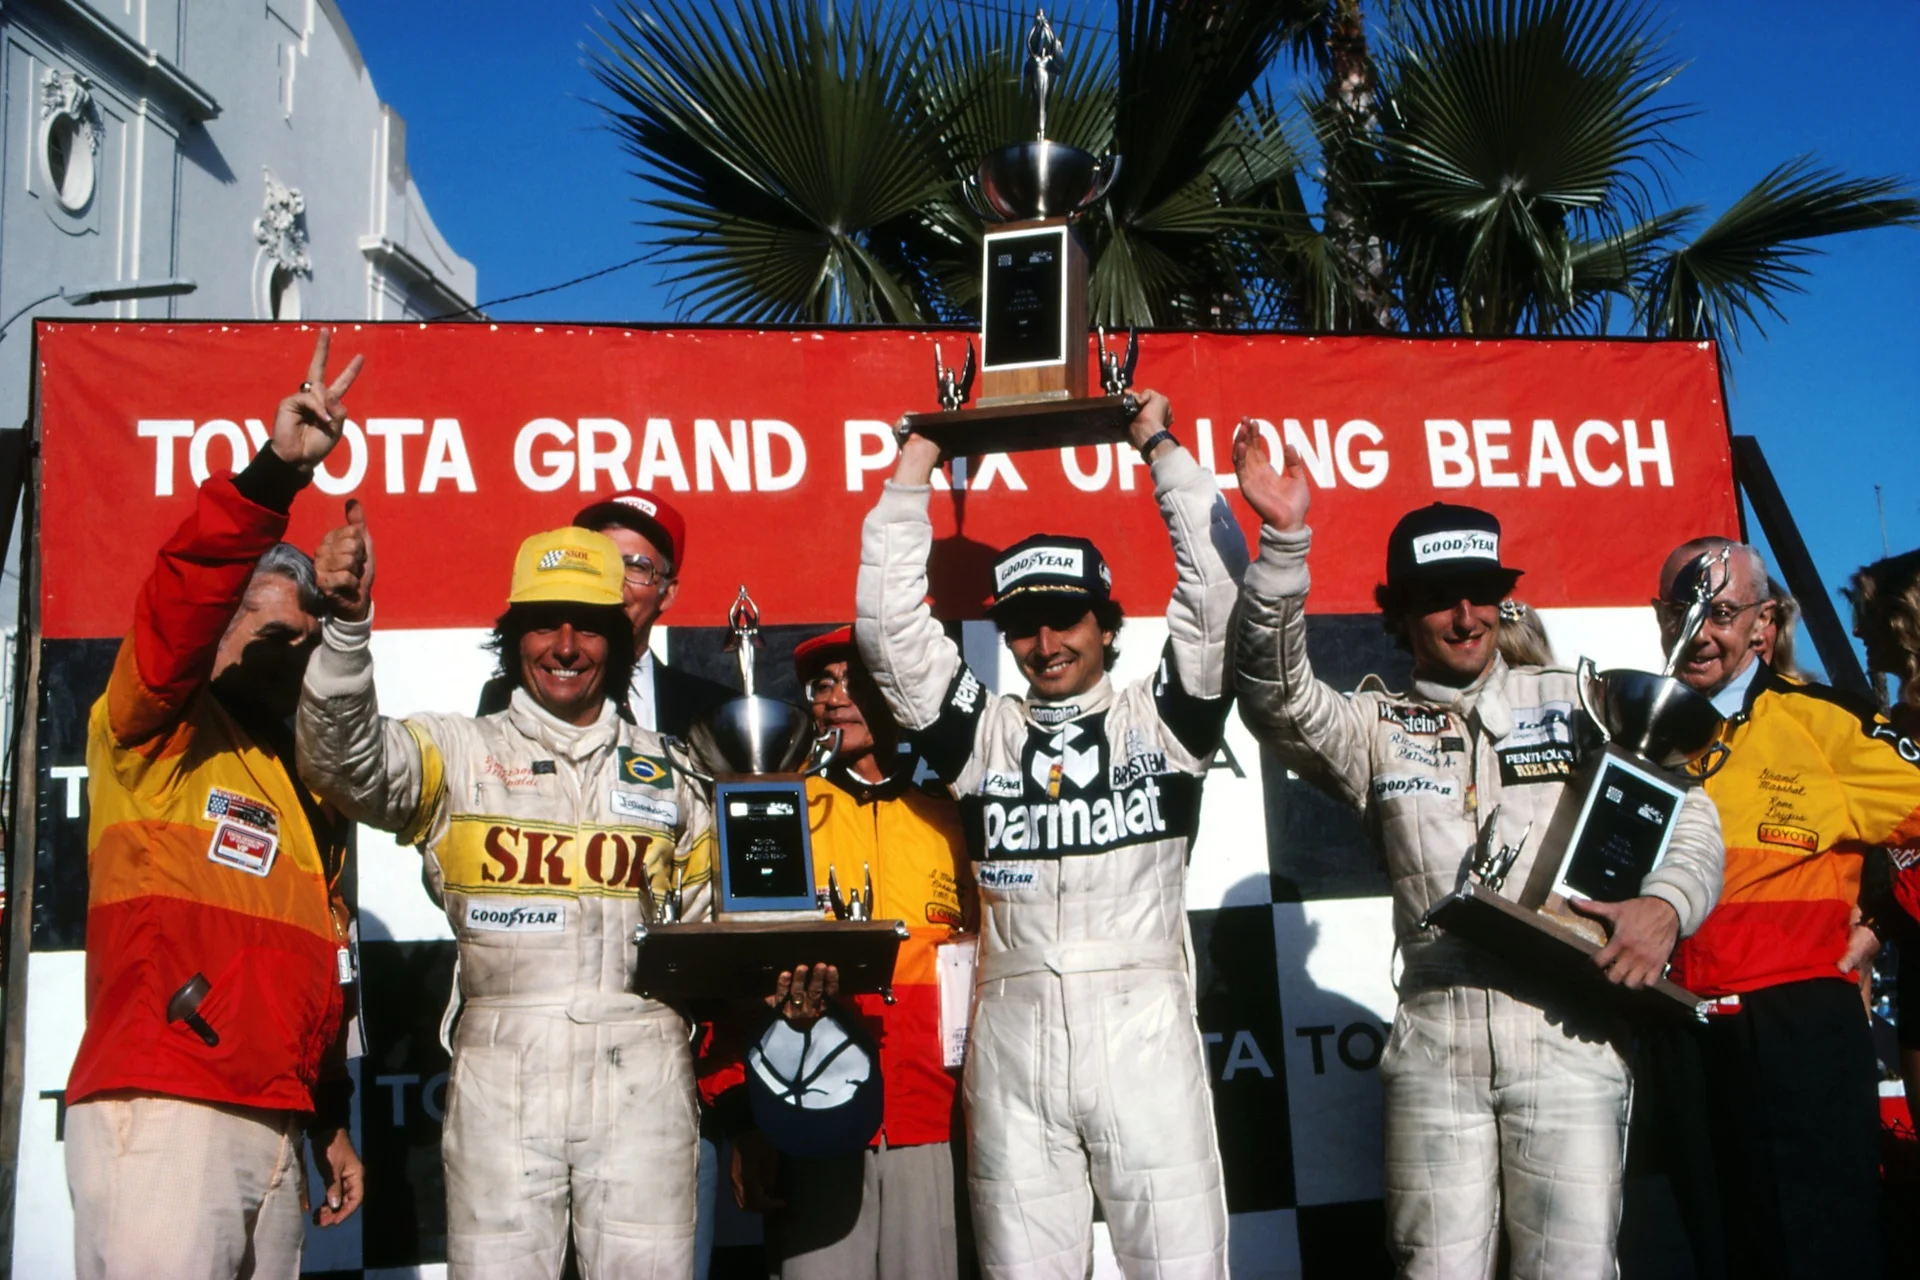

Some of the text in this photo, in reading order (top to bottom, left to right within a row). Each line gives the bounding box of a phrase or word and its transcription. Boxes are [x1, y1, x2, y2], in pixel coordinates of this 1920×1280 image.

[513, 417, 807, 494] GRAND
[844, 419, 1029, 492] PIX
[1196, 417, 1389, 490] LONG
[1424, 419, 1675, 488] BEACH
[1001, 551, 1075, 581] GOODYEAR
[1031, 704, 1080, 723] parmalat
[1380, 702, 1448, 733] Wasteinr
[1505, 748, 1574, 765] PENTHOU
[983, 777, 1166, 859] parmalat
[1762, 827, 1816, 845] TOYOTA
[979, 868, 1034, 886] YEAR
[470, 905, 558, 928] GOODYEAR
